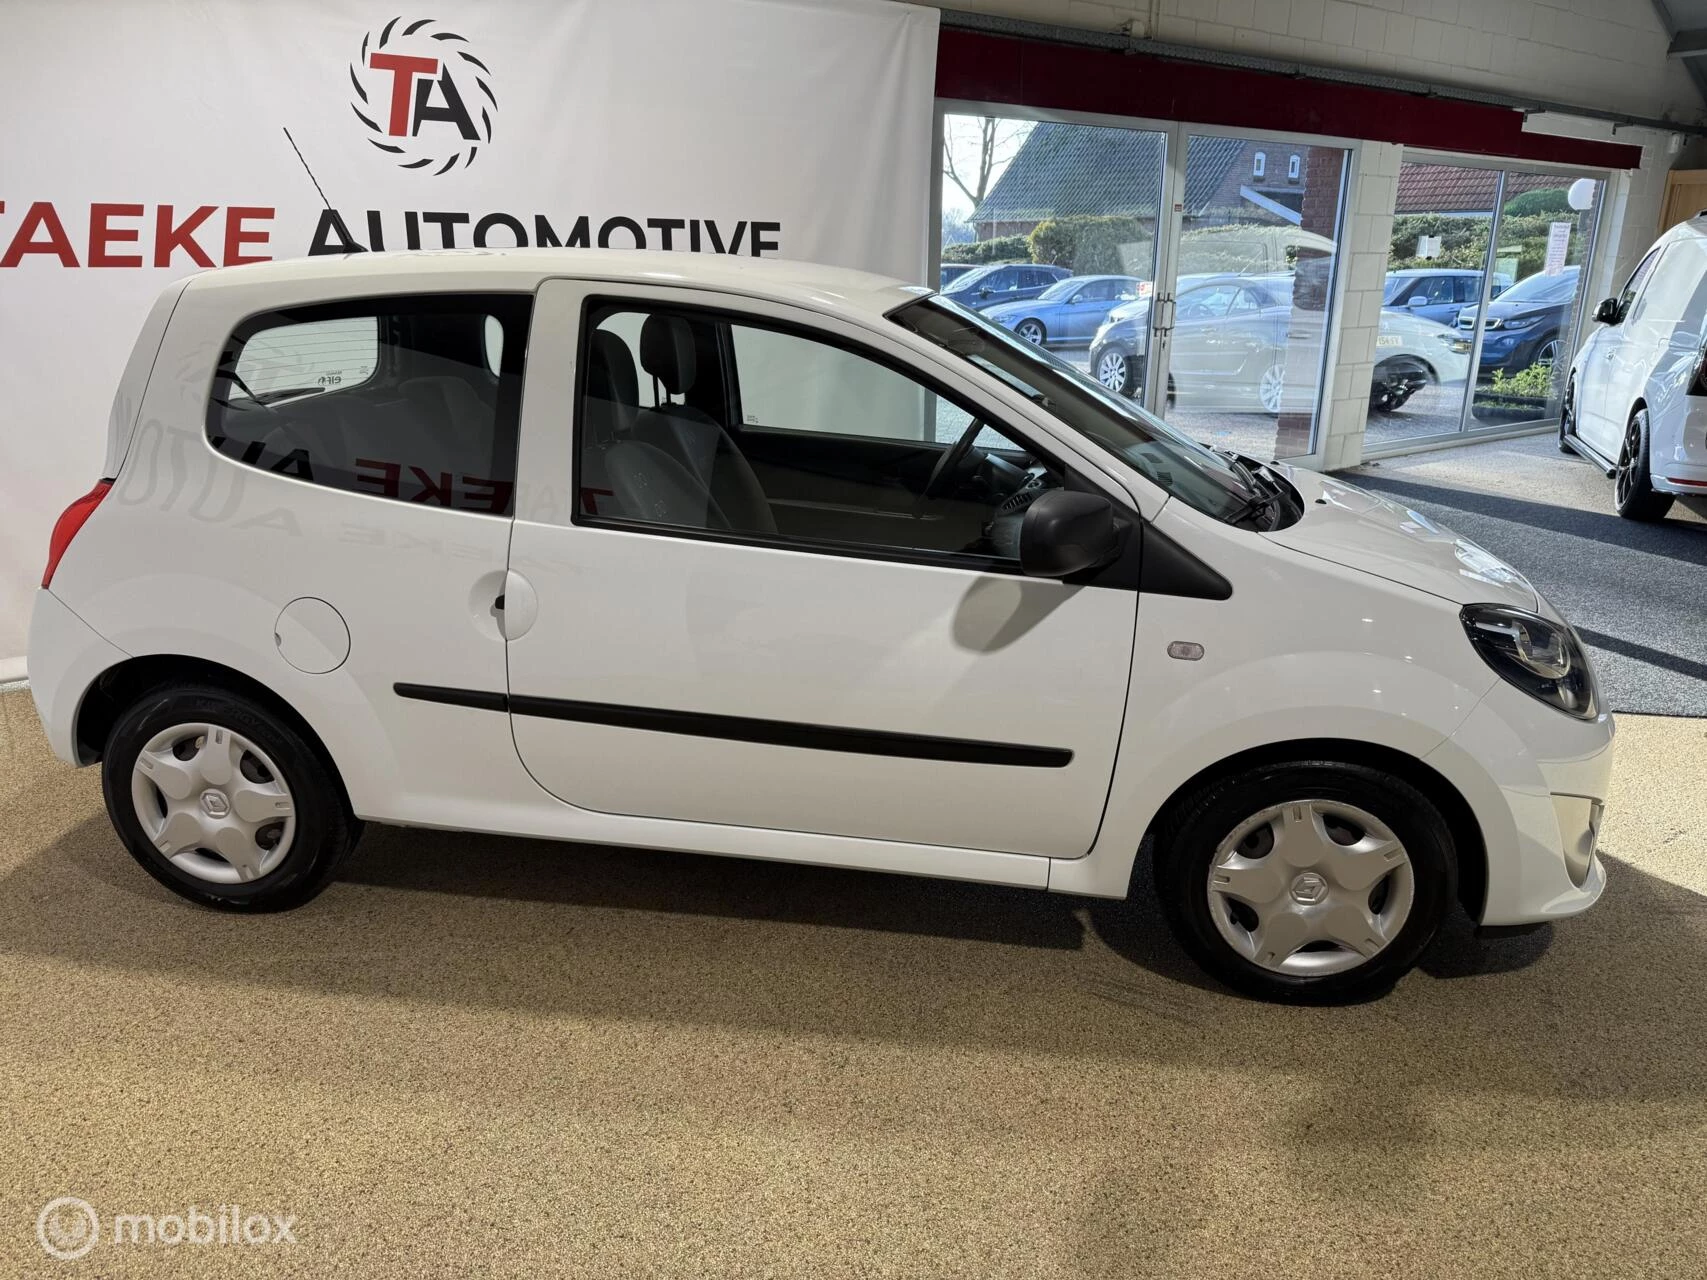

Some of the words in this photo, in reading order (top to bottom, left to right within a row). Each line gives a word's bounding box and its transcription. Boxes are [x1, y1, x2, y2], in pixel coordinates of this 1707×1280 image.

[370, 52, 481, 141] TA
[0, 201, 275, 268] AEKE
[308, 209, 780, 257] AUTOMOTIVE
